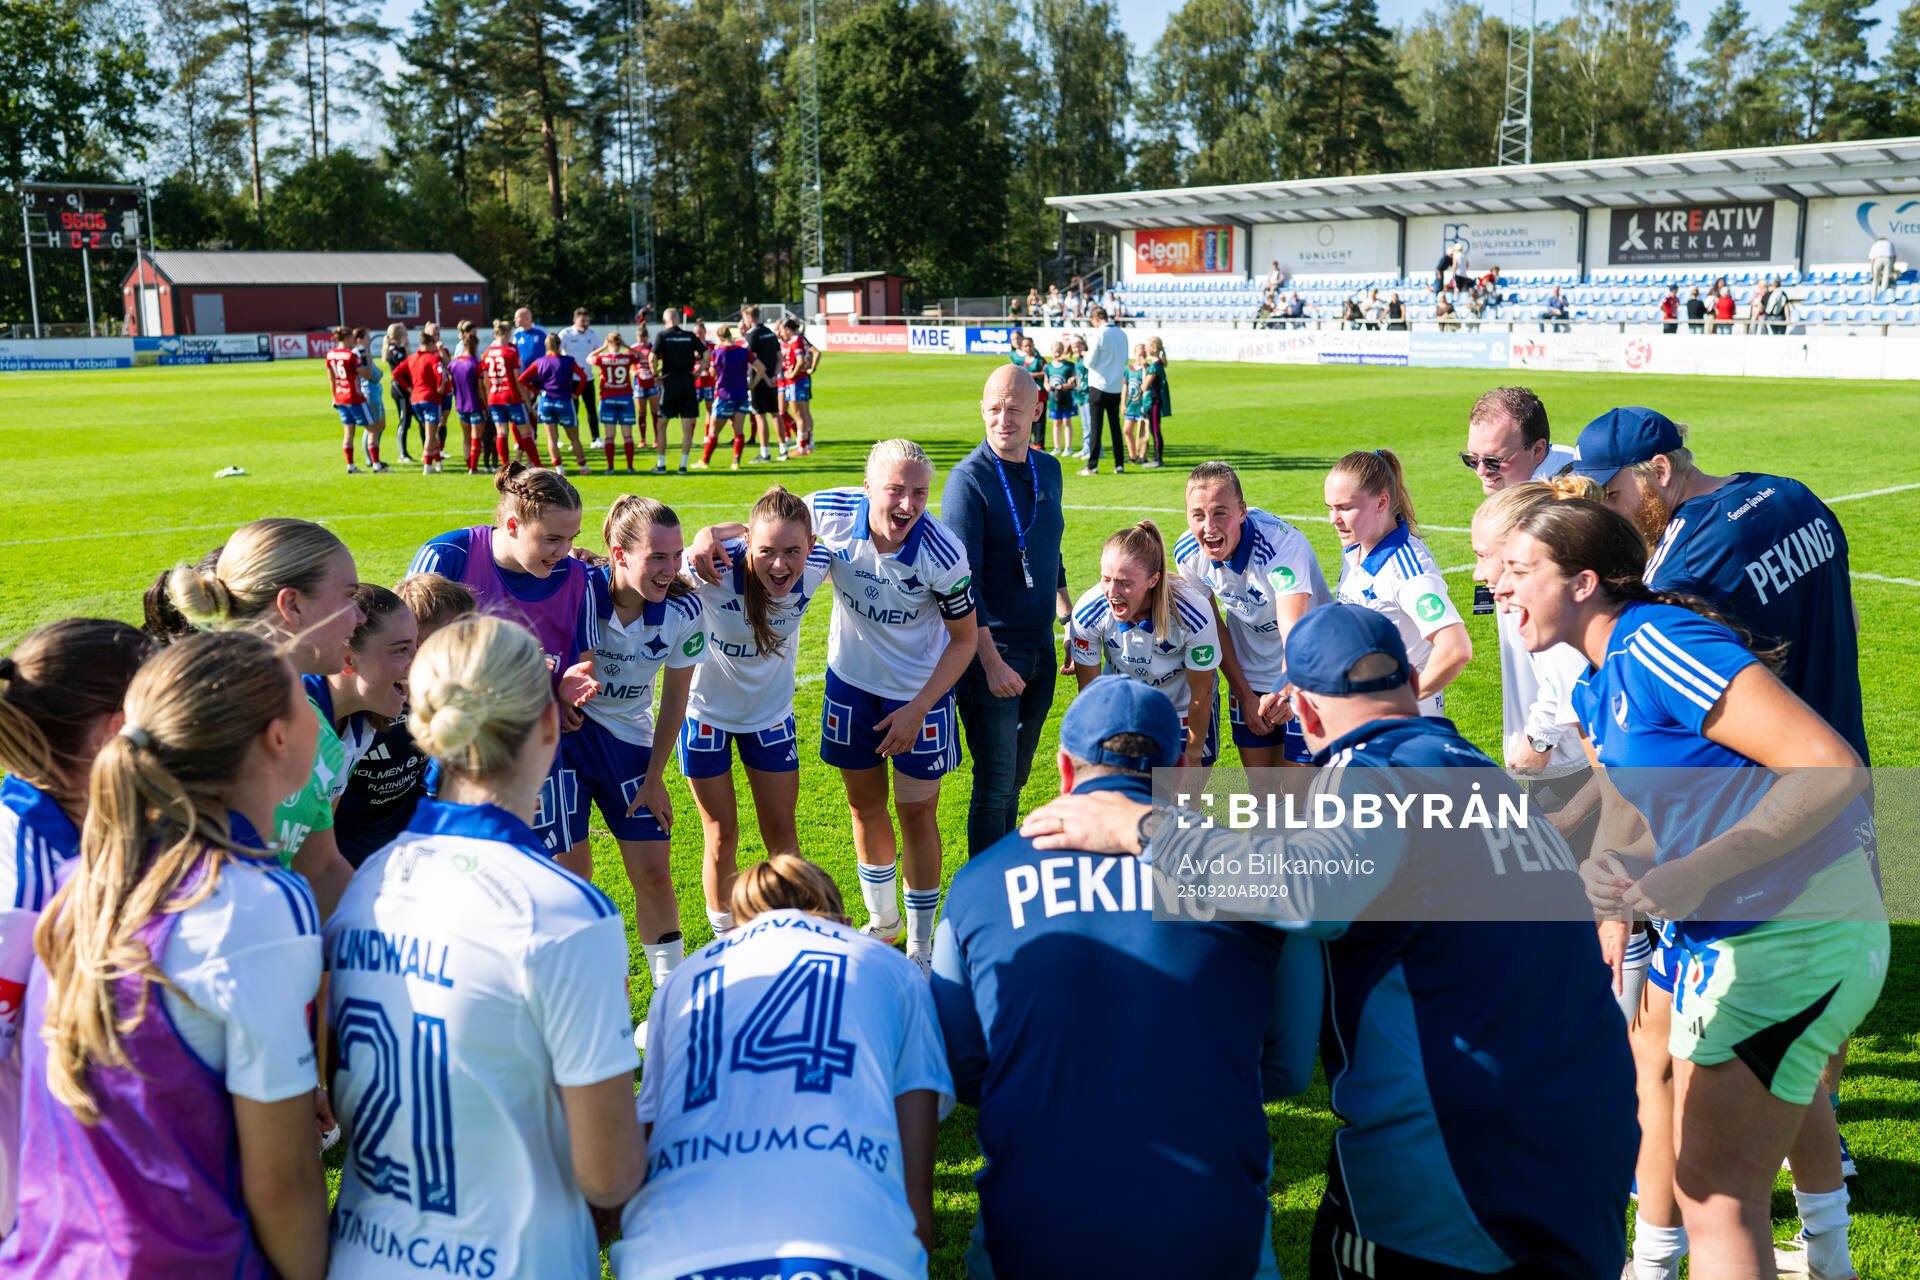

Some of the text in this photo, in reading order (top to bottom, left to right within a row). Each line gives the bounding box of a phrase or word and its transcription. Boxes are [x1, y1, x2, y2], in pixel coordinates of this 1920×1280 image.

[1654, 207, 1764, 233] KREATIV
[48, 231, 60, 248] H
[111, 232, 123, 248] G
[1138, 238, 1190, 260] clean
[1653, 233, 1757, 250] REKLAM
[1299, 250, 1353, 260] SUNLIGHT
[182, 338, 218, 351] happy
[277, 338, 303, 351] ICA
[912, 329, 950, 346] MBE
[0, 360, 28, 371] Heja
[31, 360, 72, 369] svensk
[330, 360, 347, 379] 16
[484, 357, 506, 377] 23
[605, 366, 627, 384] 19
[1745, 517, 1836, 606] PEKING
[842, 590, 920, 625] OLMEN
[594, 648, 636, 662] stadium
[368, 769, 420, 792] PLATINUMC
[682, 950, 857, 1114] 14
[335, 996, 458, 1217] 21
[645, 1124, 889, 1183] ATINUMCARS
